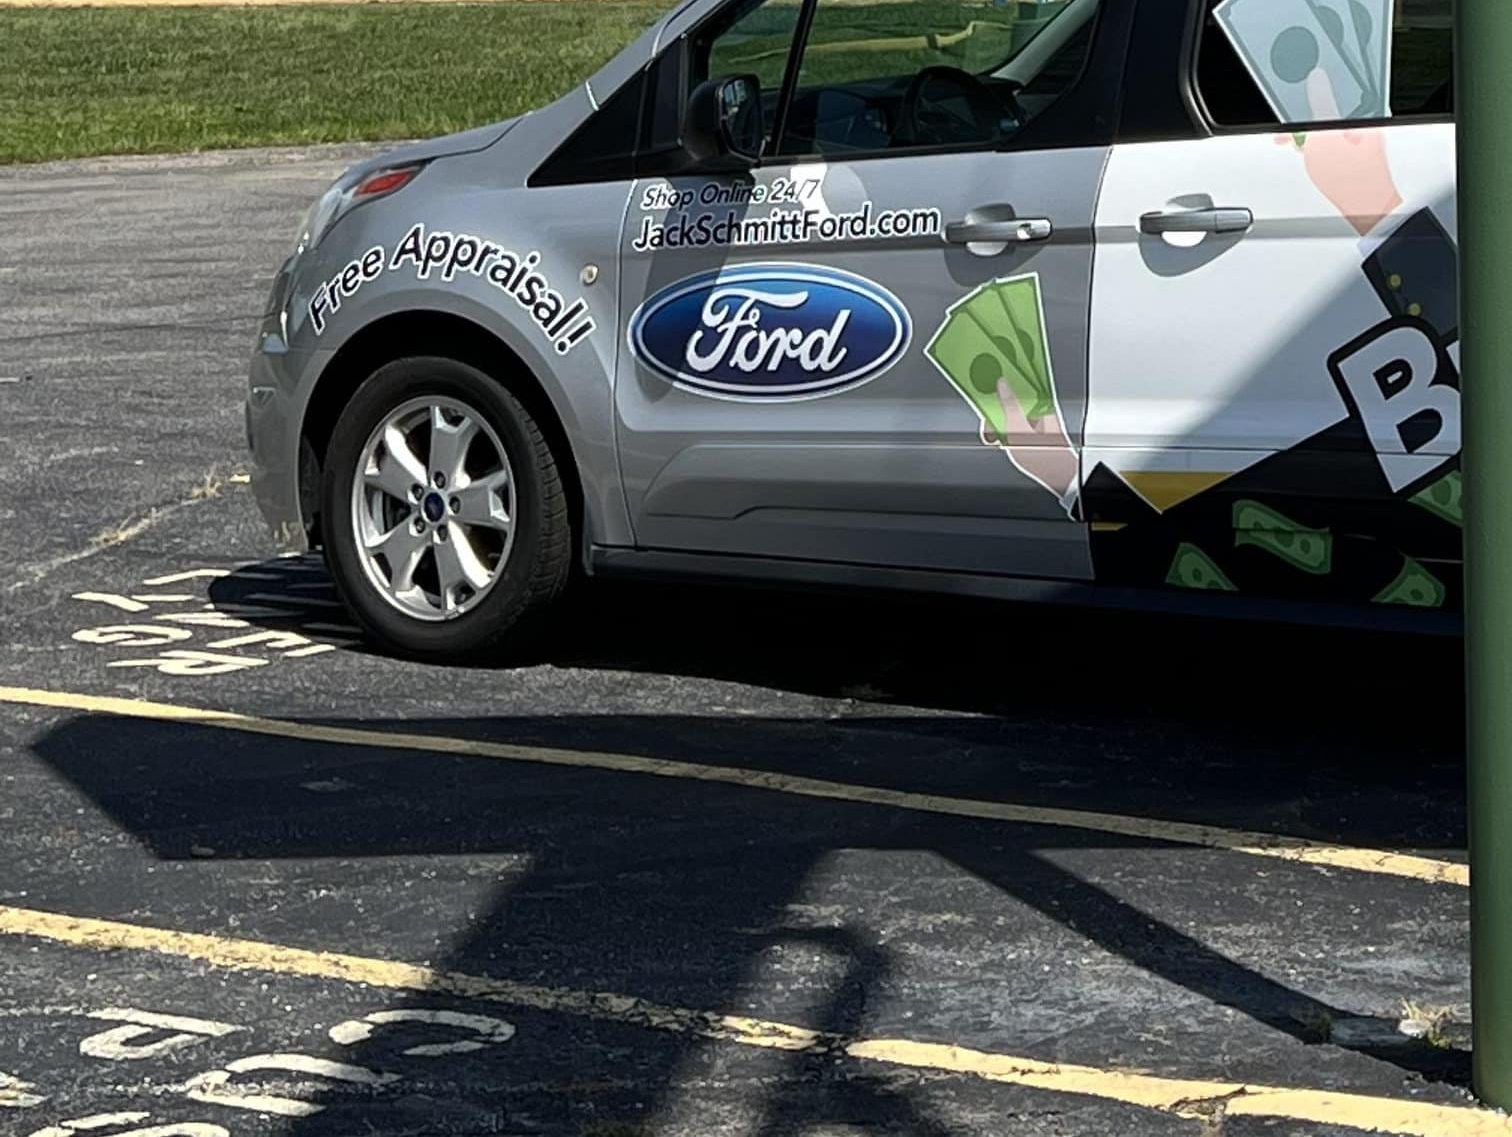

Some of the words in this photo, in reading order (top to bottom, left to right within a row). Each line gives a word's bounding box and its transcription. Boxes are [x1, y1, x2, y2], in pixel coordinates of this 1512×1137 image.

[632, 200, 941, 251] JackSchmittFord.com
[640, 184, 694, 210] Shop
[700, 180, 765, 205] Online
[768, 178, 821, 204] 24/7
[308, 244, 383, 335] Free
[390, 223, 598, 354] Appraisal!
[685, 285, 850, 373] Ford
